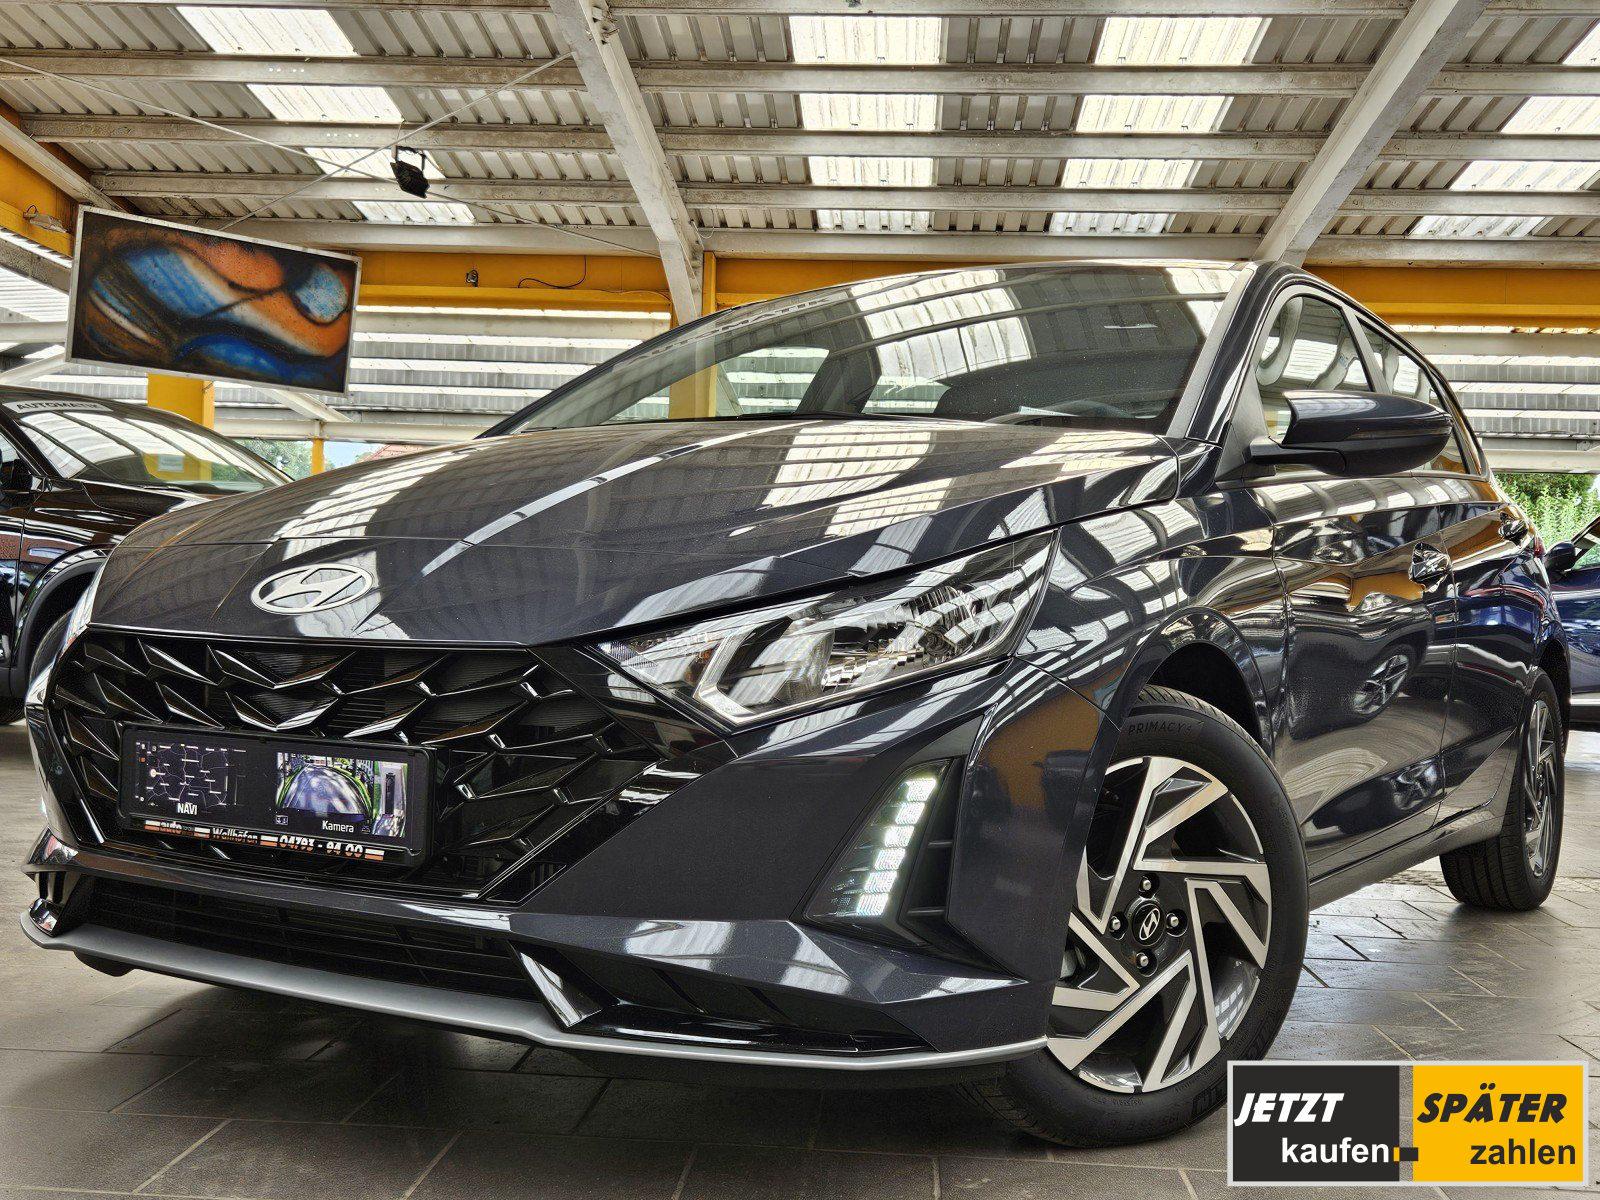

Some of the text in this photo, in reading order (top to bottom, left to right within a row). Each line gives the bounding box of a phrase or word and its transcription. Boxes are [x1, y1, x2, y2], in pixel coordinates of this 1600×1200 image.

[1128, 720, 1184, 735] PRIMACY
[177, 802, 198, 815] NAVI
[322, 820, 354, 833] Kamera
